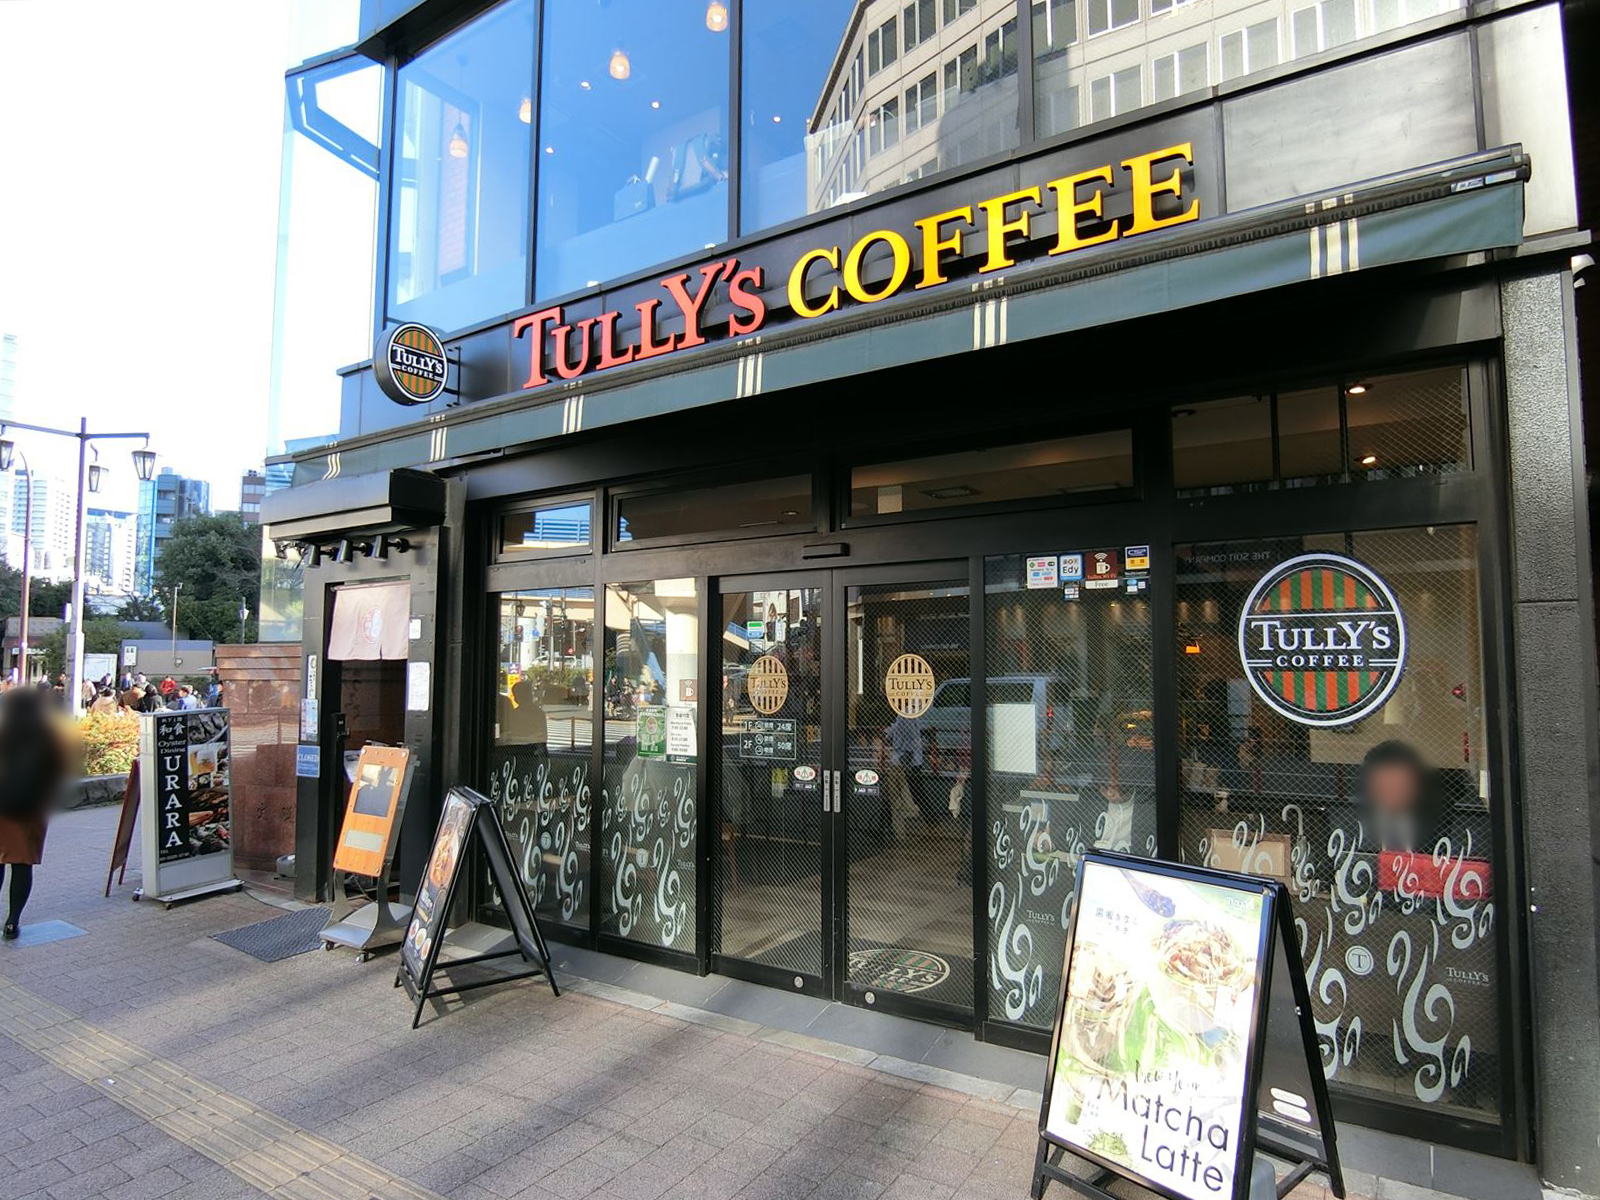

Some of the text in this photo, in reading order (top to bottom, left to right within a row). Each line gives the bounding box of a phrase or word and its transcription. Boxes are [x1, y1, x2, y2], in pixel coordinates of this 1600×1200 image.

[515, 142, 1201, 389] TULLY'S COFFEE
[393, 346, 443, 374] TULLY'S
[402, 365, 434, 378] COFFEE
[1062, 566, 1079, 575] Edy
[1251, 621, 1391, 650] TULLY'S
[1276, 655, 1364, 667] COFFEE
[888, 678, 932, 691] TULLY'S
[160, 722, 186, 736] 和食
[744, 721, 753, 730] 1F
[158, 740, 187, 748] Oyster
[743, 740, 753, 749] 2F
[164, 755, 183, 848] URARA
[1027, 909, 1056, 922] TULLY'S
[1446, 967, 1489, 982] TULLY'S
[1097, 1079, 1229, 1151] Matcha
[1141, 1124, 1223, 1192] Latte
